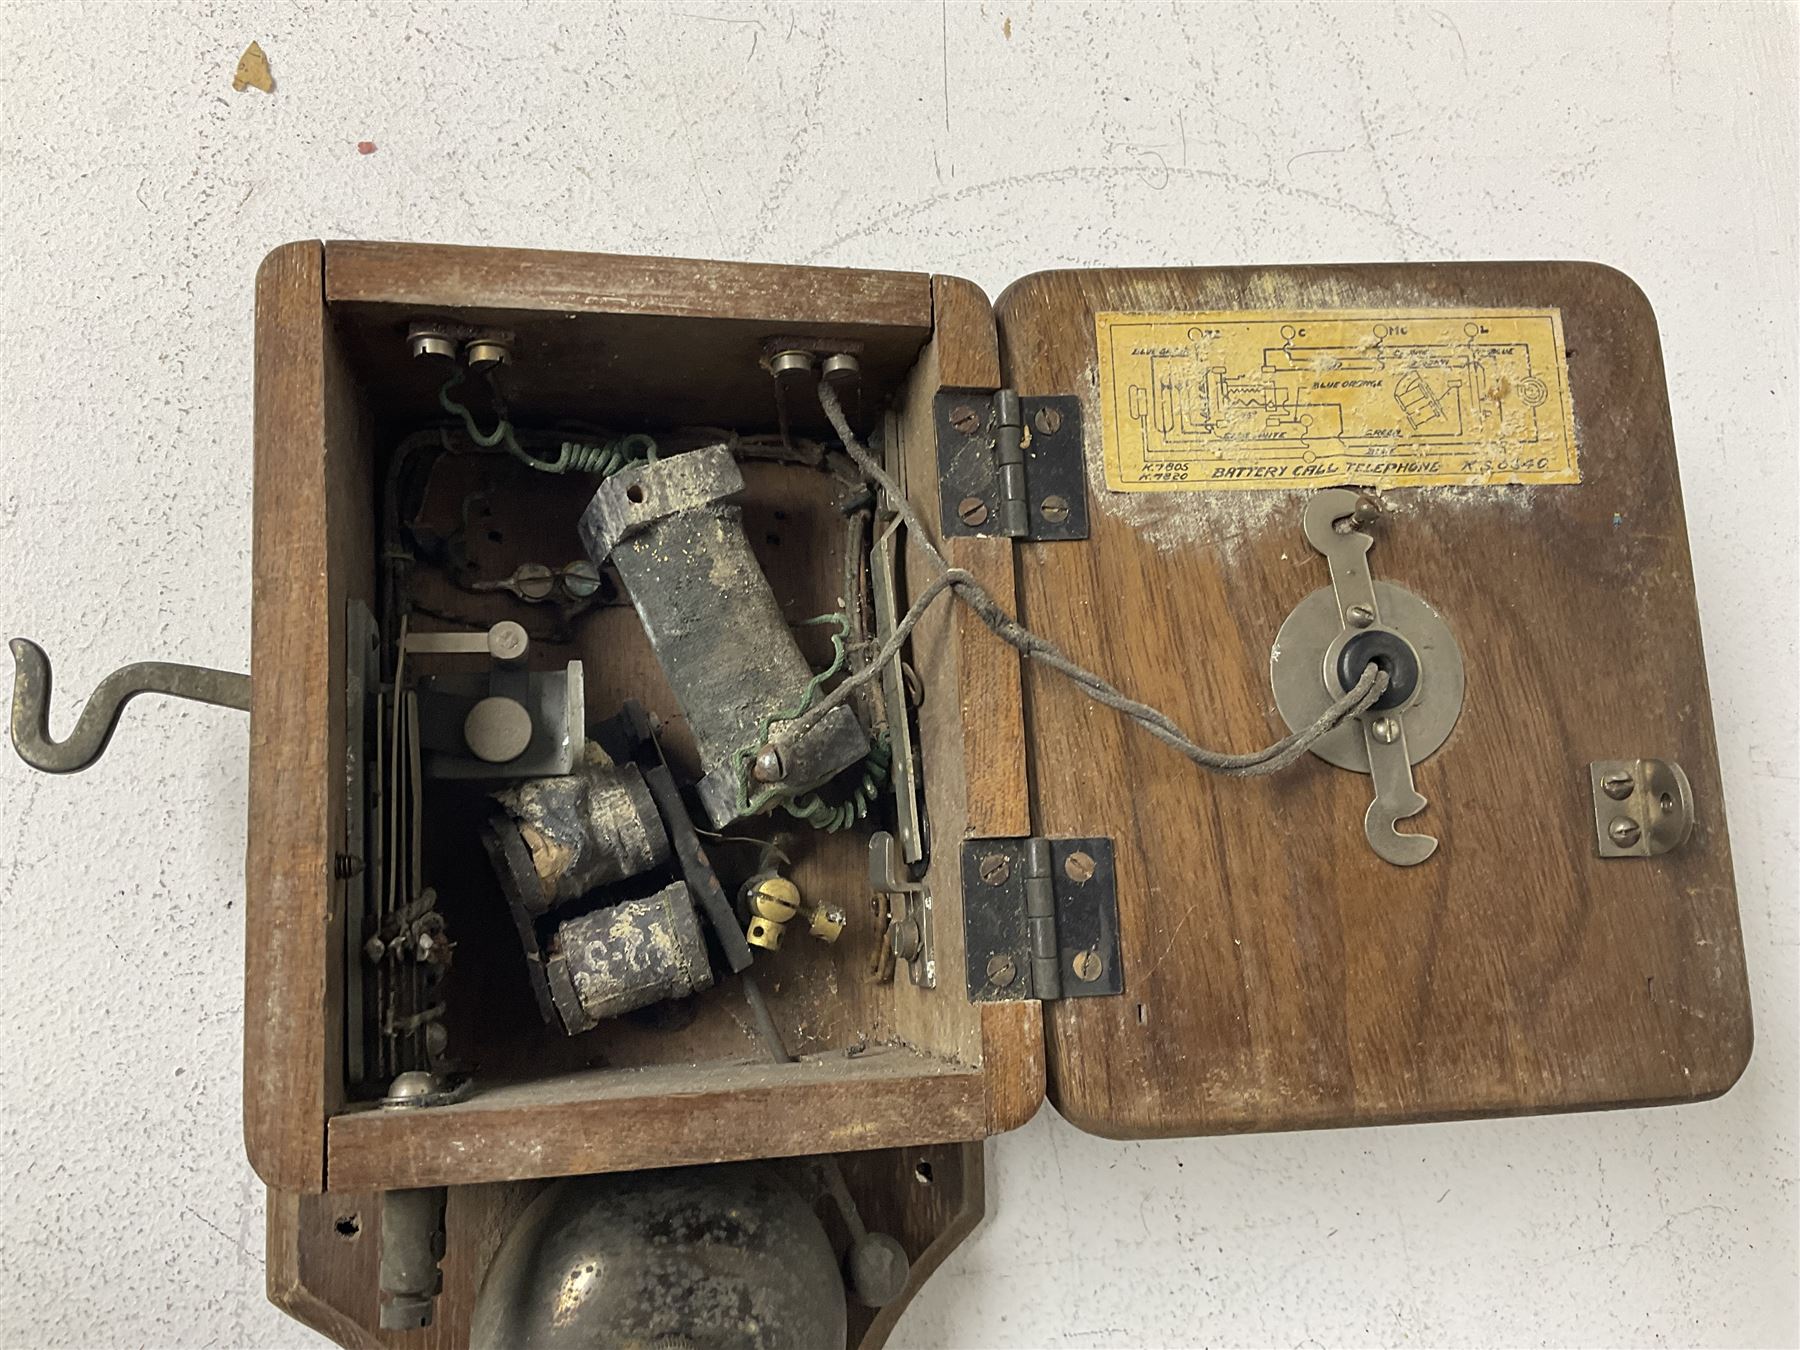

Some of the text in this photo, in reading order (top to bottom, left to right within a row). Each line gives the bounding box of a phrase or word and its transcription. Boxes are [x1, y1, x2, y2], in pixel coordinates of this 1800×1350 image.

[1298, 328, 1306, 338] C
[1479, 325, 1489, 334] L
[1313, 381, 1339, 390] BLUE
[1211, 461, 1441, 479] BATTERY CALL TELEPHONE
